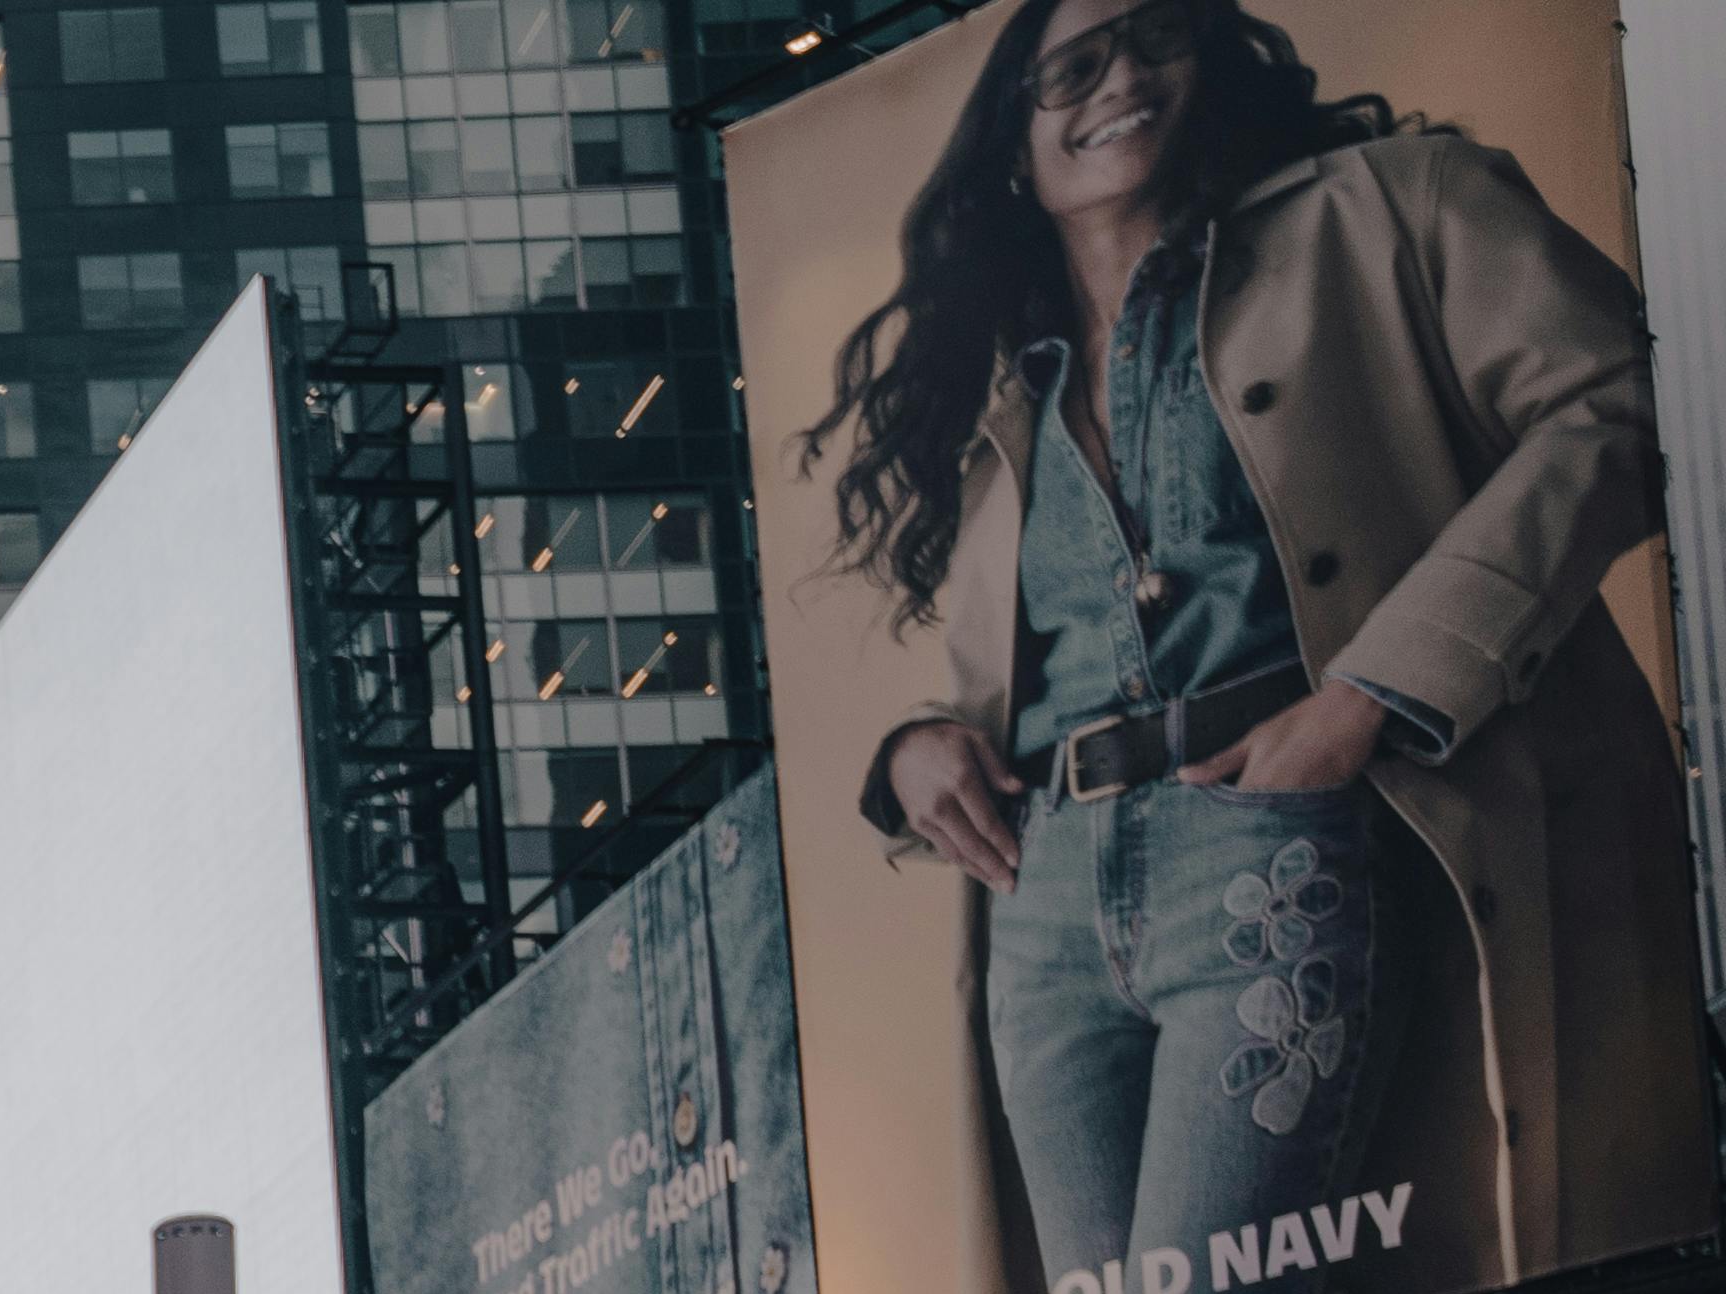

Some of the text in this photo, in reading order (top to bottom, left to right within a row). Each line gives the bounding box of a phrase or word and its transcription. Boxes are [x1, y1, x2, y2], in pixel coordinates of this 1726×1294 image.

[471, 1198, 552, 1284] There
[555, 1162, 602, 1229] We
[1208, 1180, 1414, 1294] NAVY
